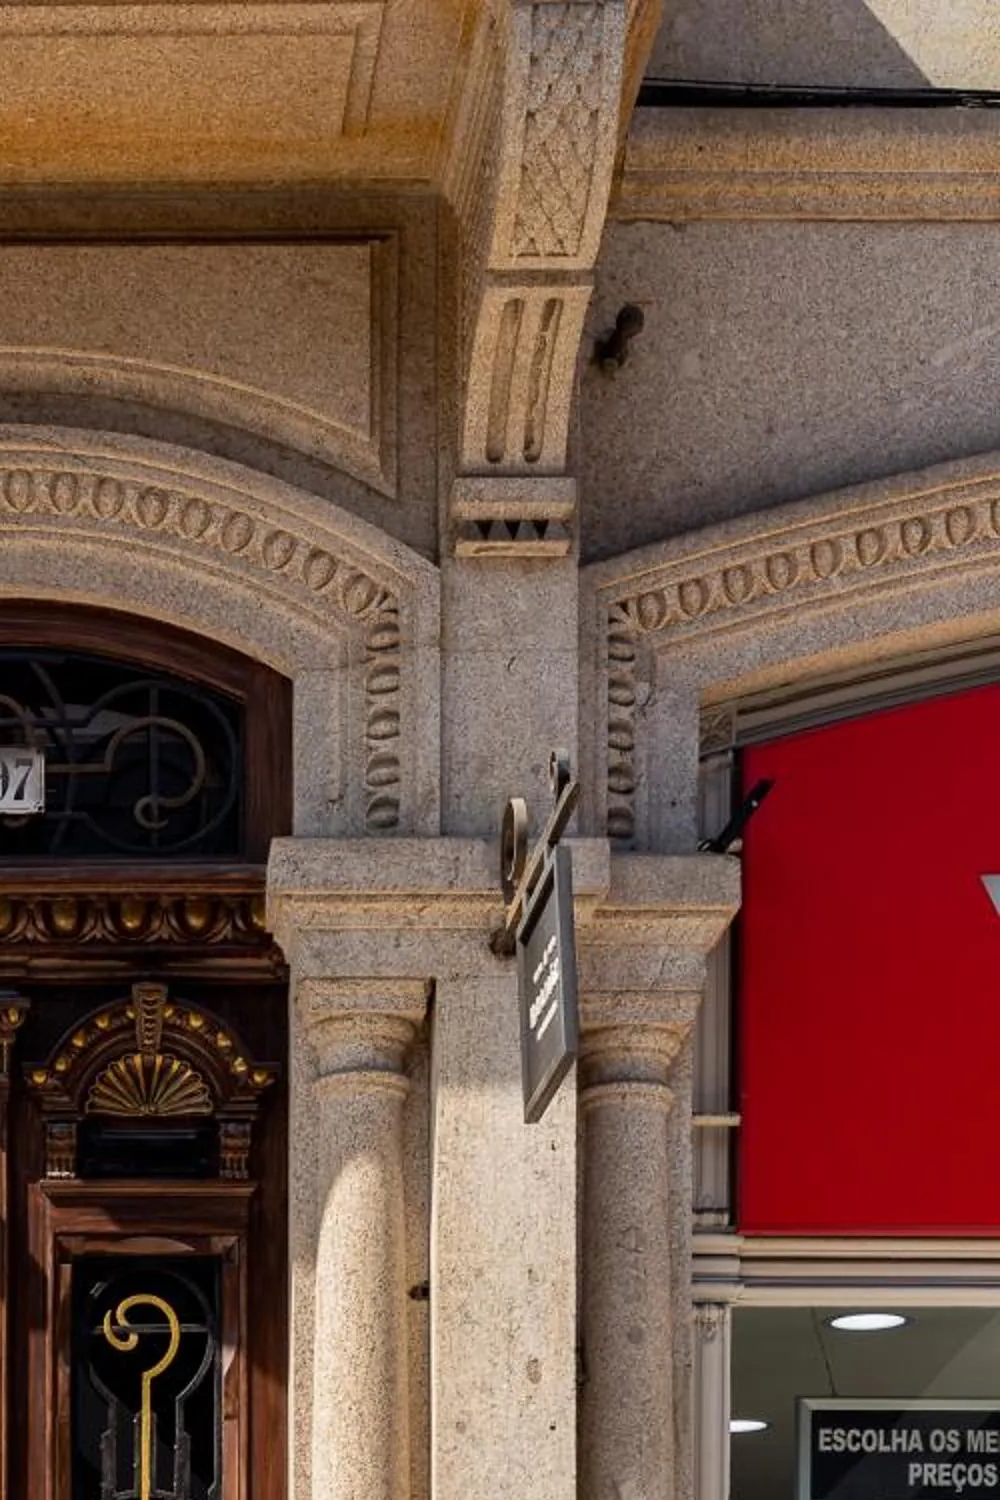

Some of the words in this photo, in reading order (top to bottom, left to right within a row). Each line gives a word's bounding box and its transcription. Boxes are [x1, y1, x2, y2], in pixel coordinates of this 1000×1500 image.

[818, 1429, 923, 1452] ESCOLHA
[930, 1430, 960, 1452] OS
[908, 1463, 998, 1492] PREÇOS
